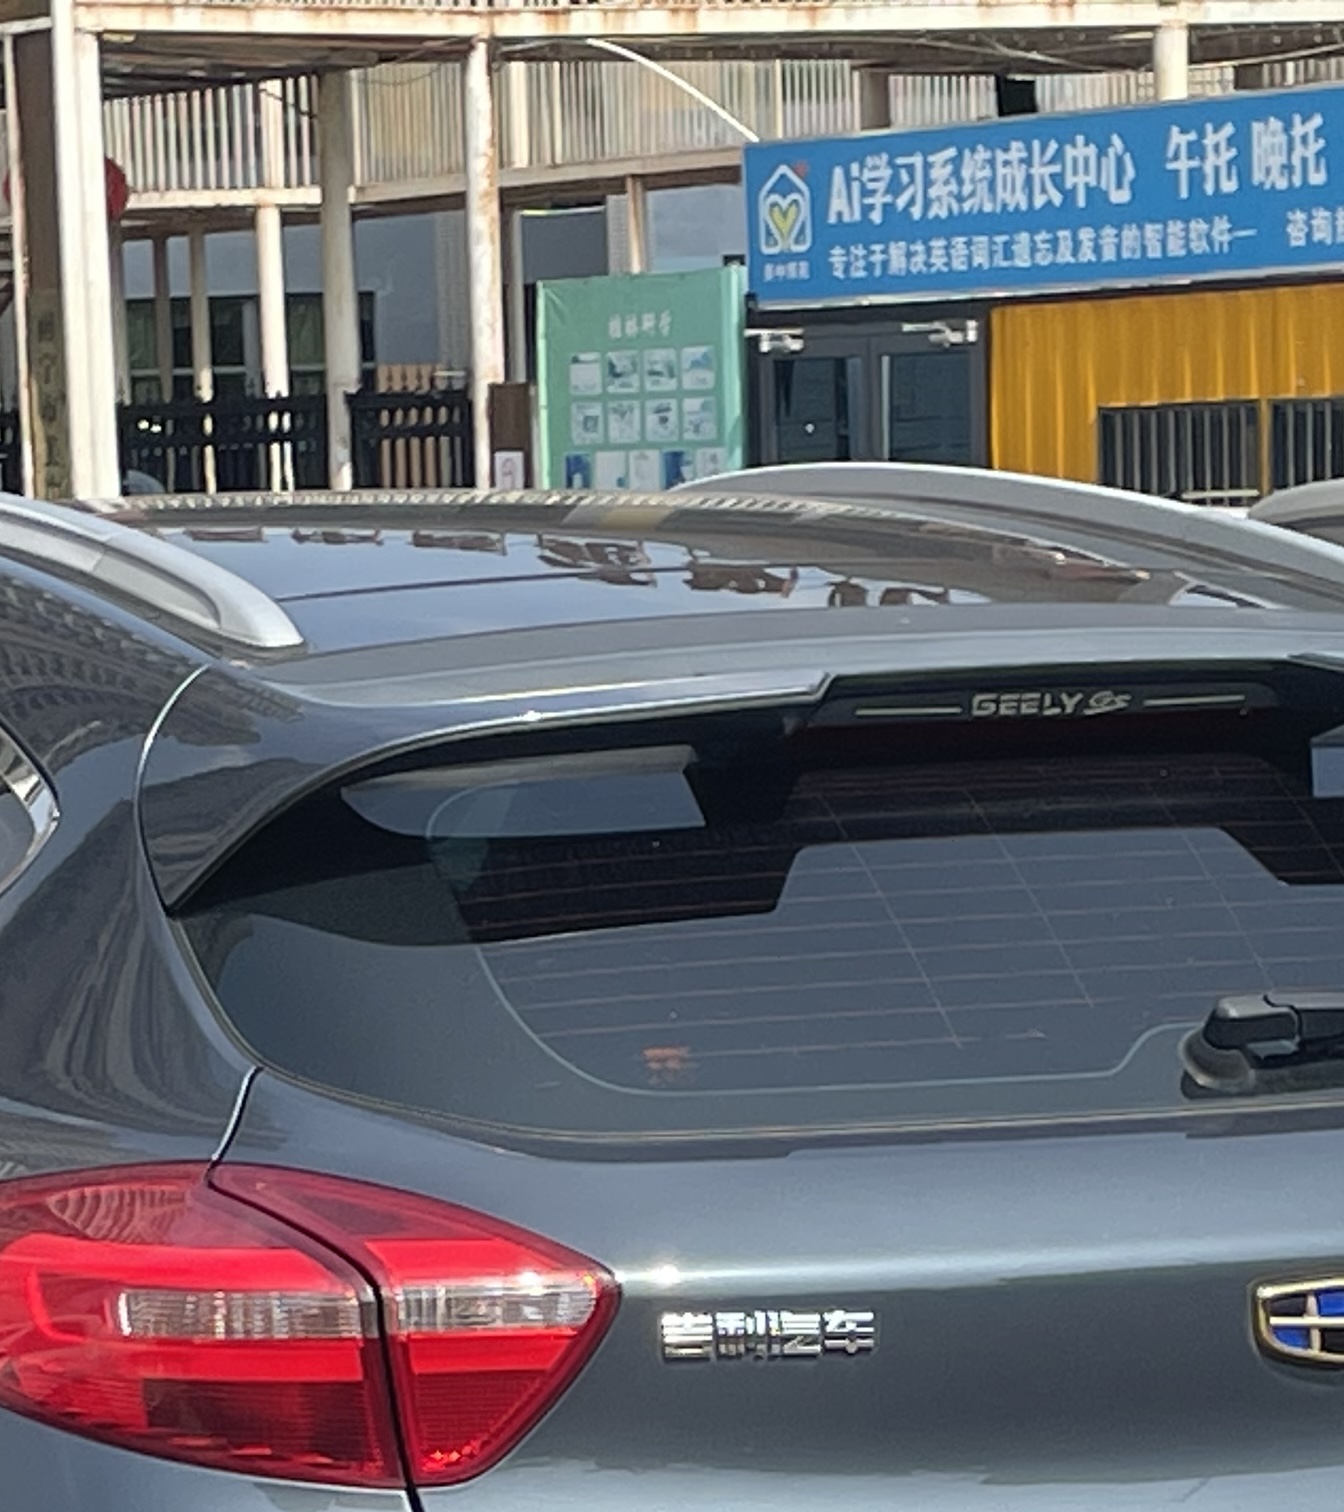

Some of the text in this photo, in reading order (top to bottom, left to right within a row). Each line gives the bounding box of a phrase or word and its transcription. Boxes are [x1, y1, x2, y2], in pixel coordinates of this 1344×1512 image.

[1166, 123, 1239, 199] 午托
[1251, 112, 1327, 190] 晚托
[971, 692, 1083, 716] GEELY
